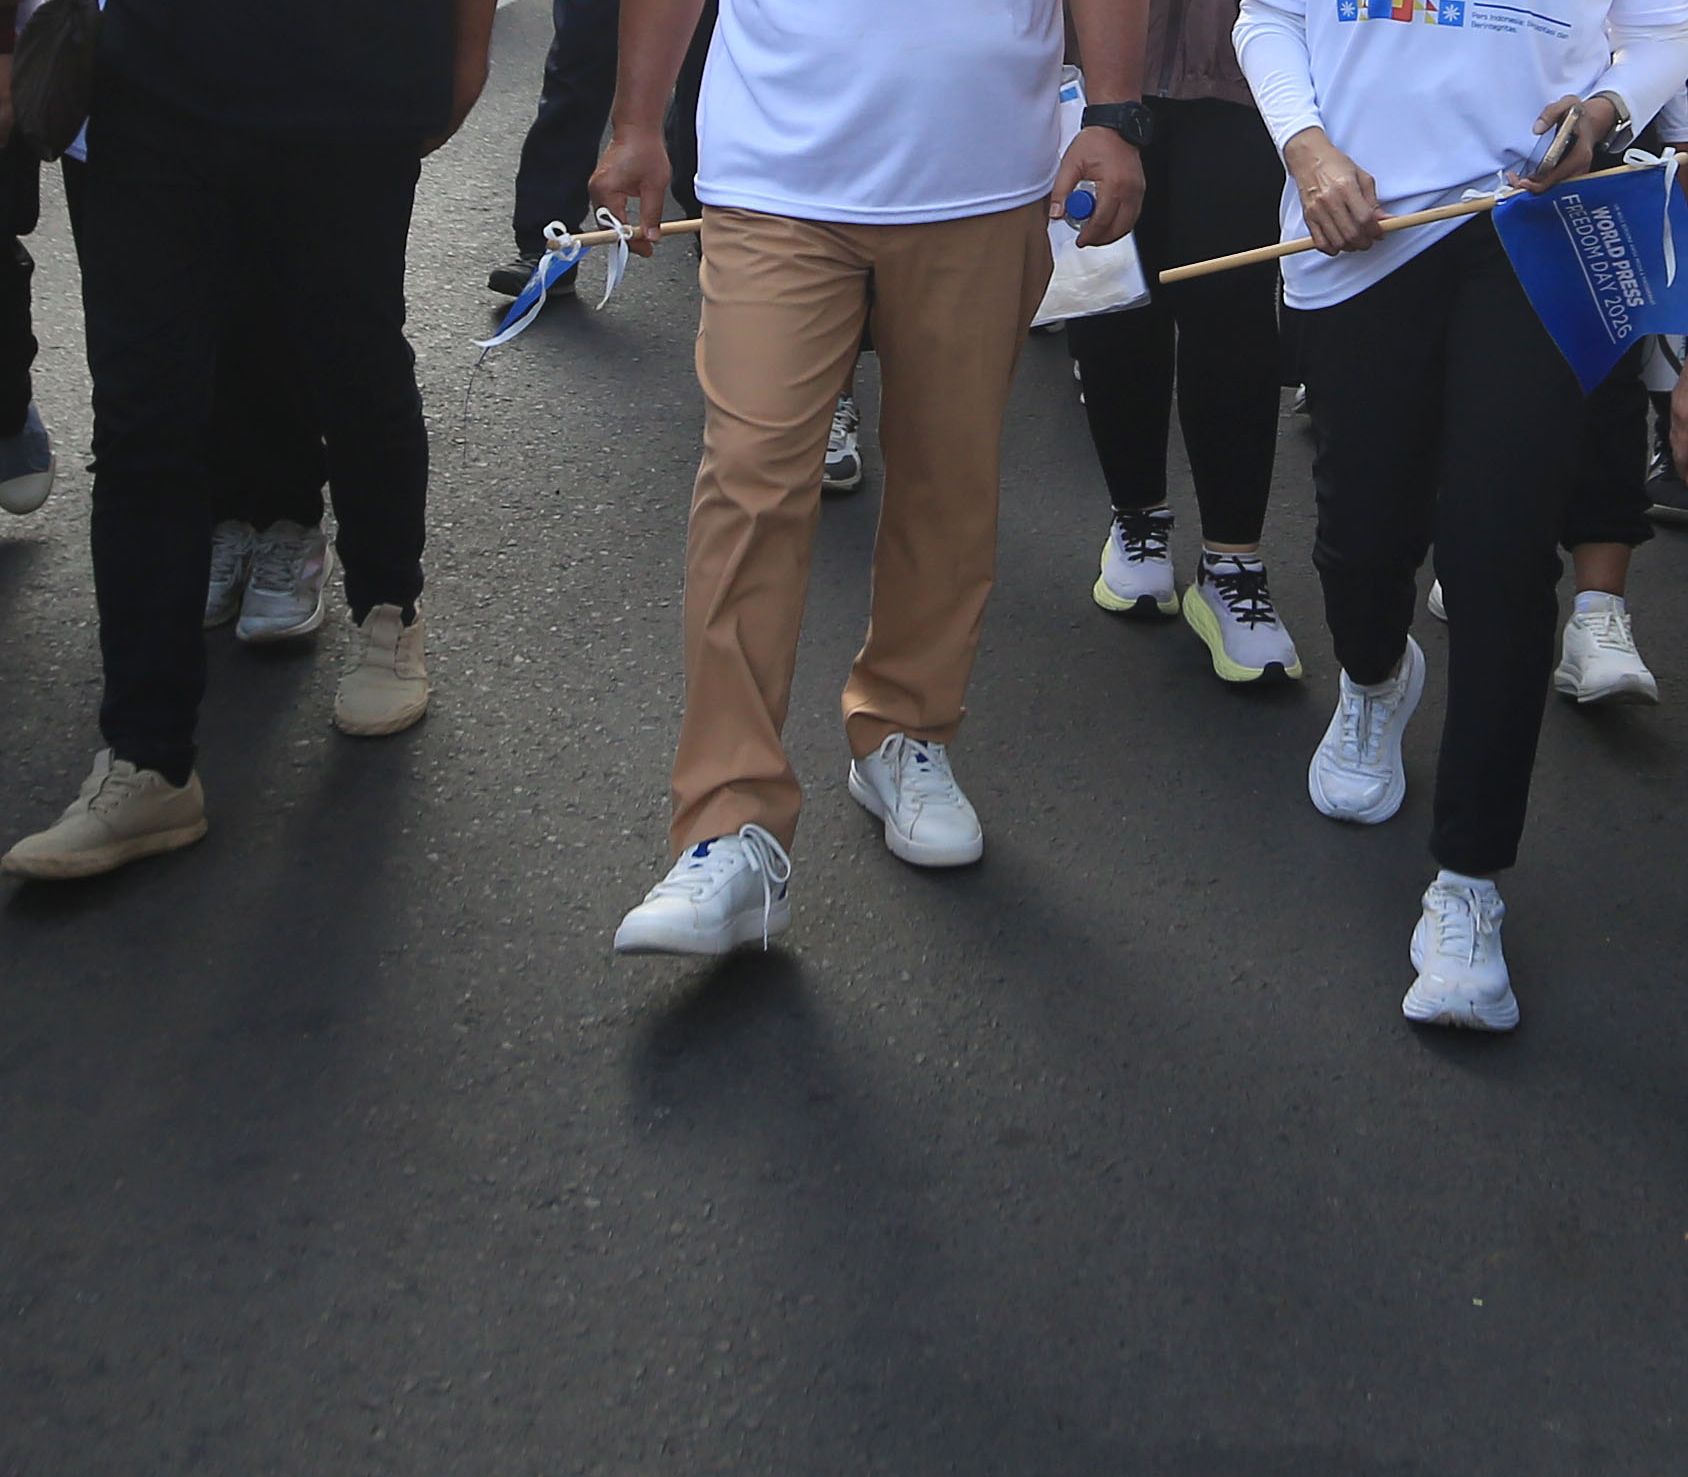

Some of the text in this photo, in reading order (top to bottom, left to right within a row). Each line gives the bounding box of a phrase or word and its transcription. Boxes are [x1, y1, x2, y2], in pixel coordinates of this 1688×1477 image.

[1561, 194, 1632, 340] FREEDOM DAY 2026
[1591, 205, 1625, 258] WORLD
[1613, 259, 1644, 307] PRESS
